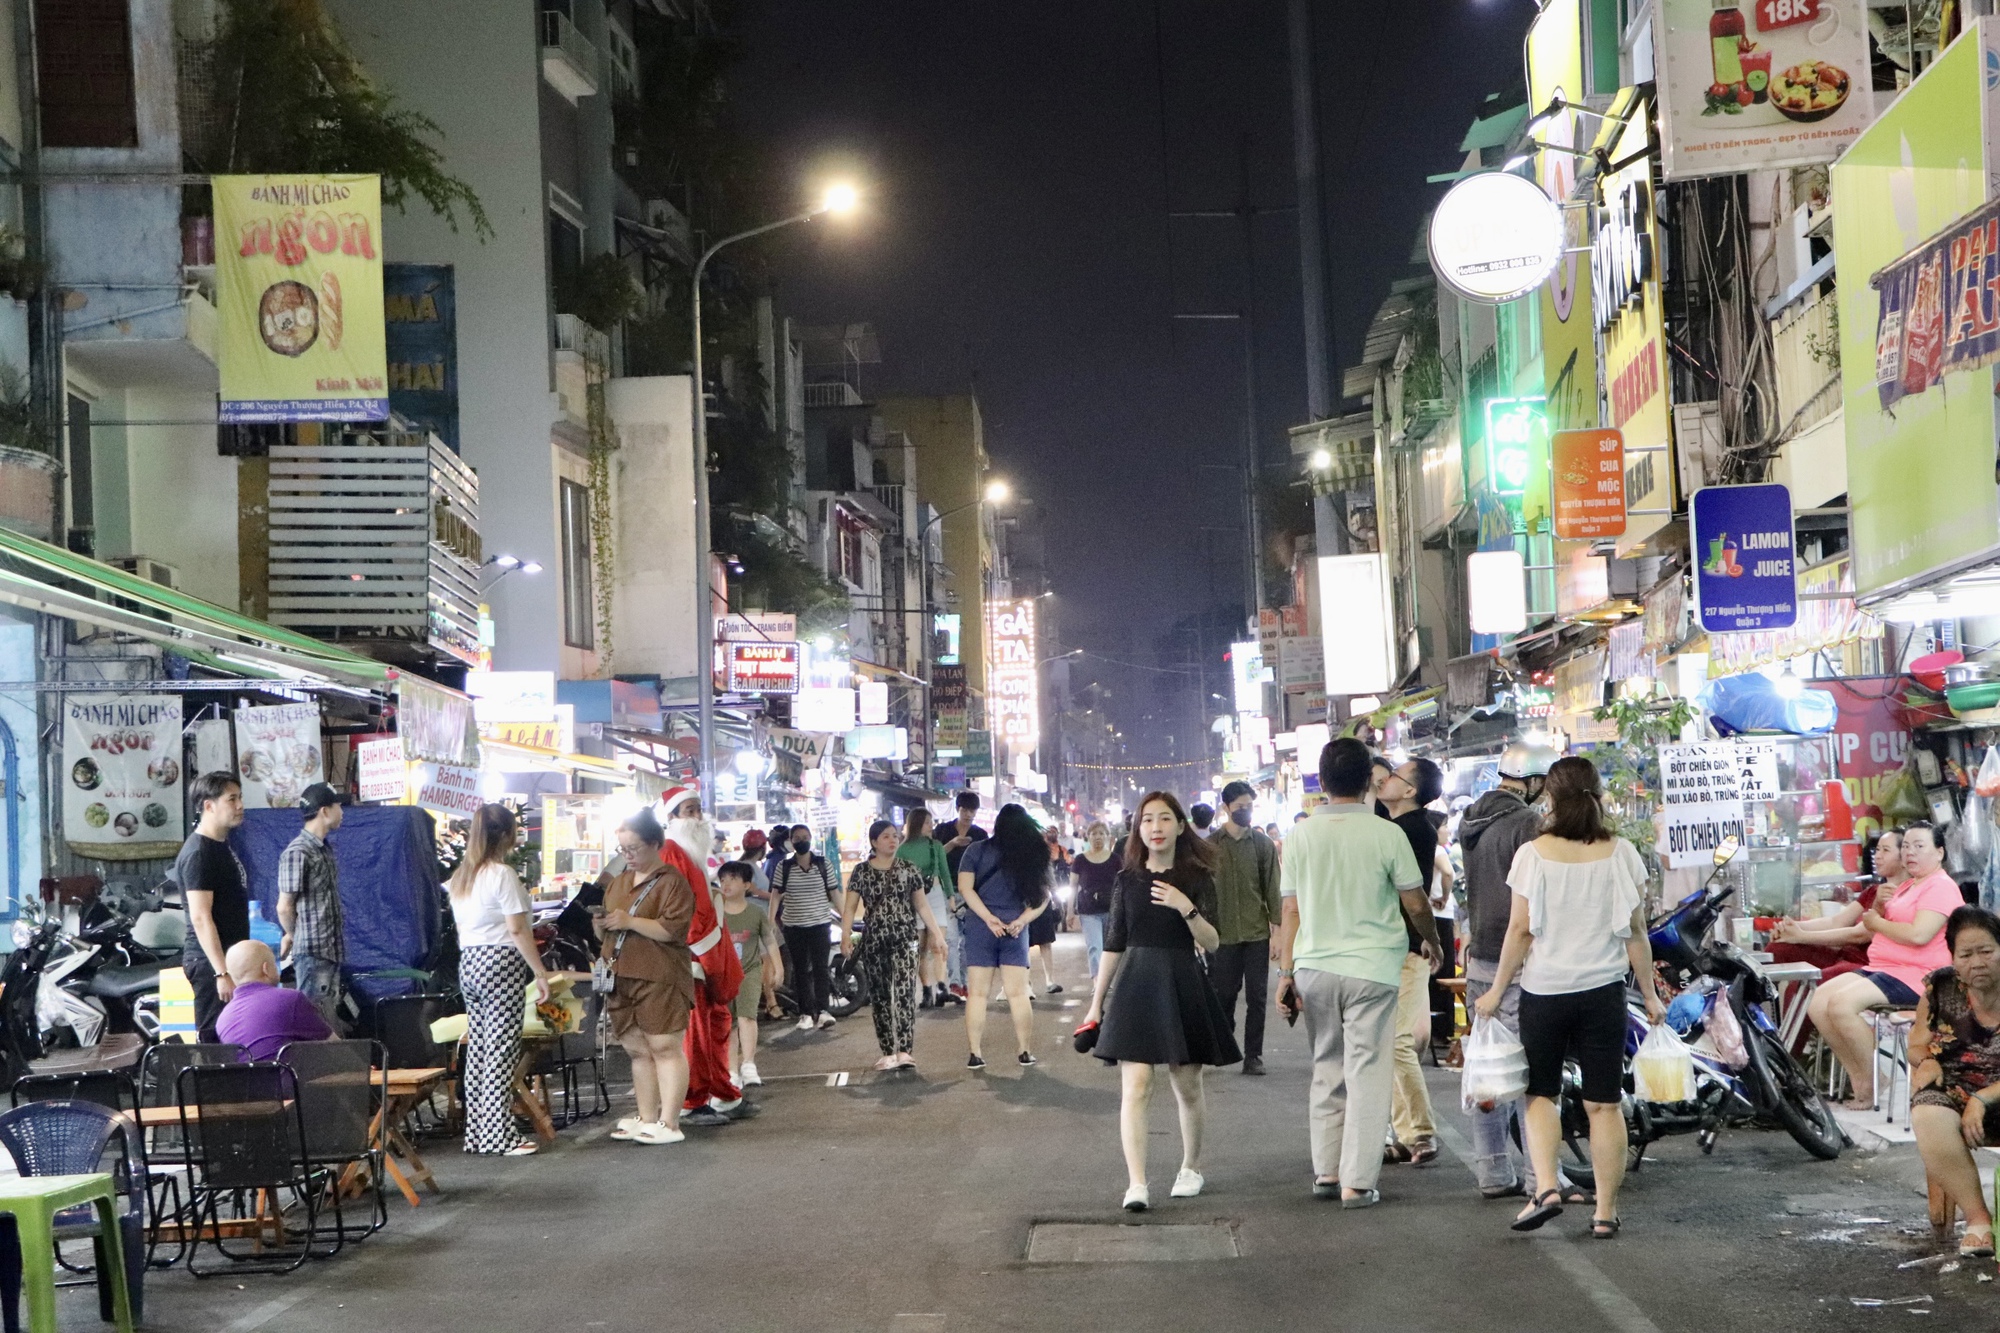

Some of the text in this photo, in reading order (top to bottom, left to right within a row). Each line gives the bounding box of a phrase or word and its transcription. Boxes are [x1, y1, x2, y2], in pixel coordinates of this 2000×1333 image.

[1742, 138, 1771, 147] TRONG
[251, 181, 290, 206] BÁNH
[294, 178, 310, 206] MÌ
[239, 208, 376, 266] ngon
[1599, 437, 1618, 453] SÚP
[1600, 459, 1619, 472] CUA
[1597, 478, 1620, 496] MỘC
[1742, 532, 1789, 550] LAMON
[1754, 560, 1791, 577] JUICE
[1705, 607, 1717, 617] 217
[1719, 604, 1746, 617] Nguyễn
[1747, 604, 1774, 617] Thượng
[997, 607, 1031, 635] GÀ
[1736, 616, 1761, 628] Quận 3
[743, 645, 772, 659] BÁNH
[999, 640, 1030, 662] TA
[735, 677, 794, 690] CAMPUCHIA
[71, 698, 112, 724] BÁNH
[117, 698, 135, 727] MÌ
[91, 728, 156, 755] ngon
[1670, 759, 1687, 775] BỘT
[1689, 758, 1712, 773] CHIÊN
[436, 766, 462, 787] Bánh
[1667, 775, 1677, 789] MÌ
[1679, 774, 1695, 788] XÀO
[1712, 773, 1736, 786] TRỨNG
[1666, 793, 1680, 805] NUI
[1683, 789, 1698, 804] XÀO
[1714, 788, 1739, 801] TRỨNG
[1669, 819, 1688, 859] BỘT
[1691, 816, 1720, 853] CHIÊN
